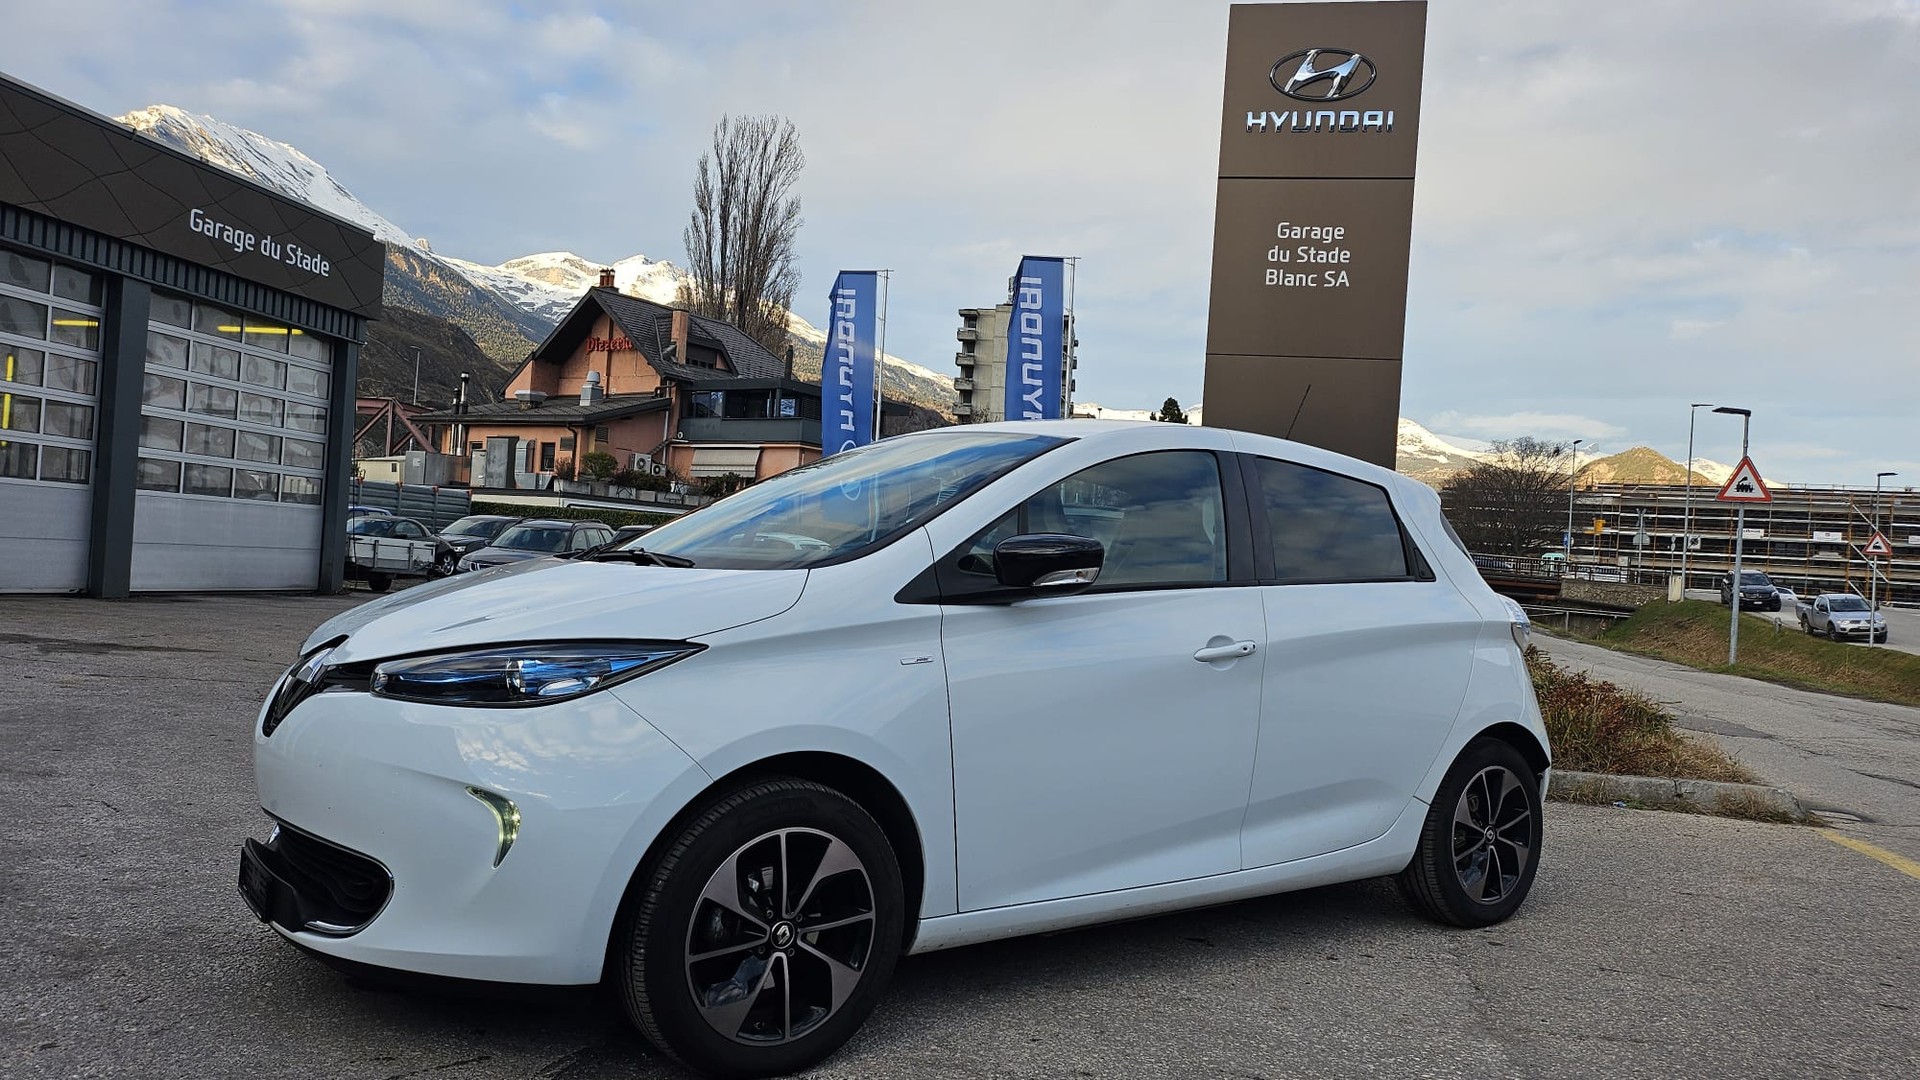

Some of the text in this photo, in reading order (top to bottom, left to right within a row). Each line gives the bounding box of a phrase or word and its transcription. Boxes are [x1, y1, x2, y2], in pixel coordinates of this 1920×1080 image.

[1246, 110, 1395, 133] HYUNDAI
[190, 208, 330, 277] Garage du Stade
[1277, 222, 1345, 243] Garage
[1267, 245, 1351, 263] du Stade
[1265, 269, 1350, 287] Blanc SA
